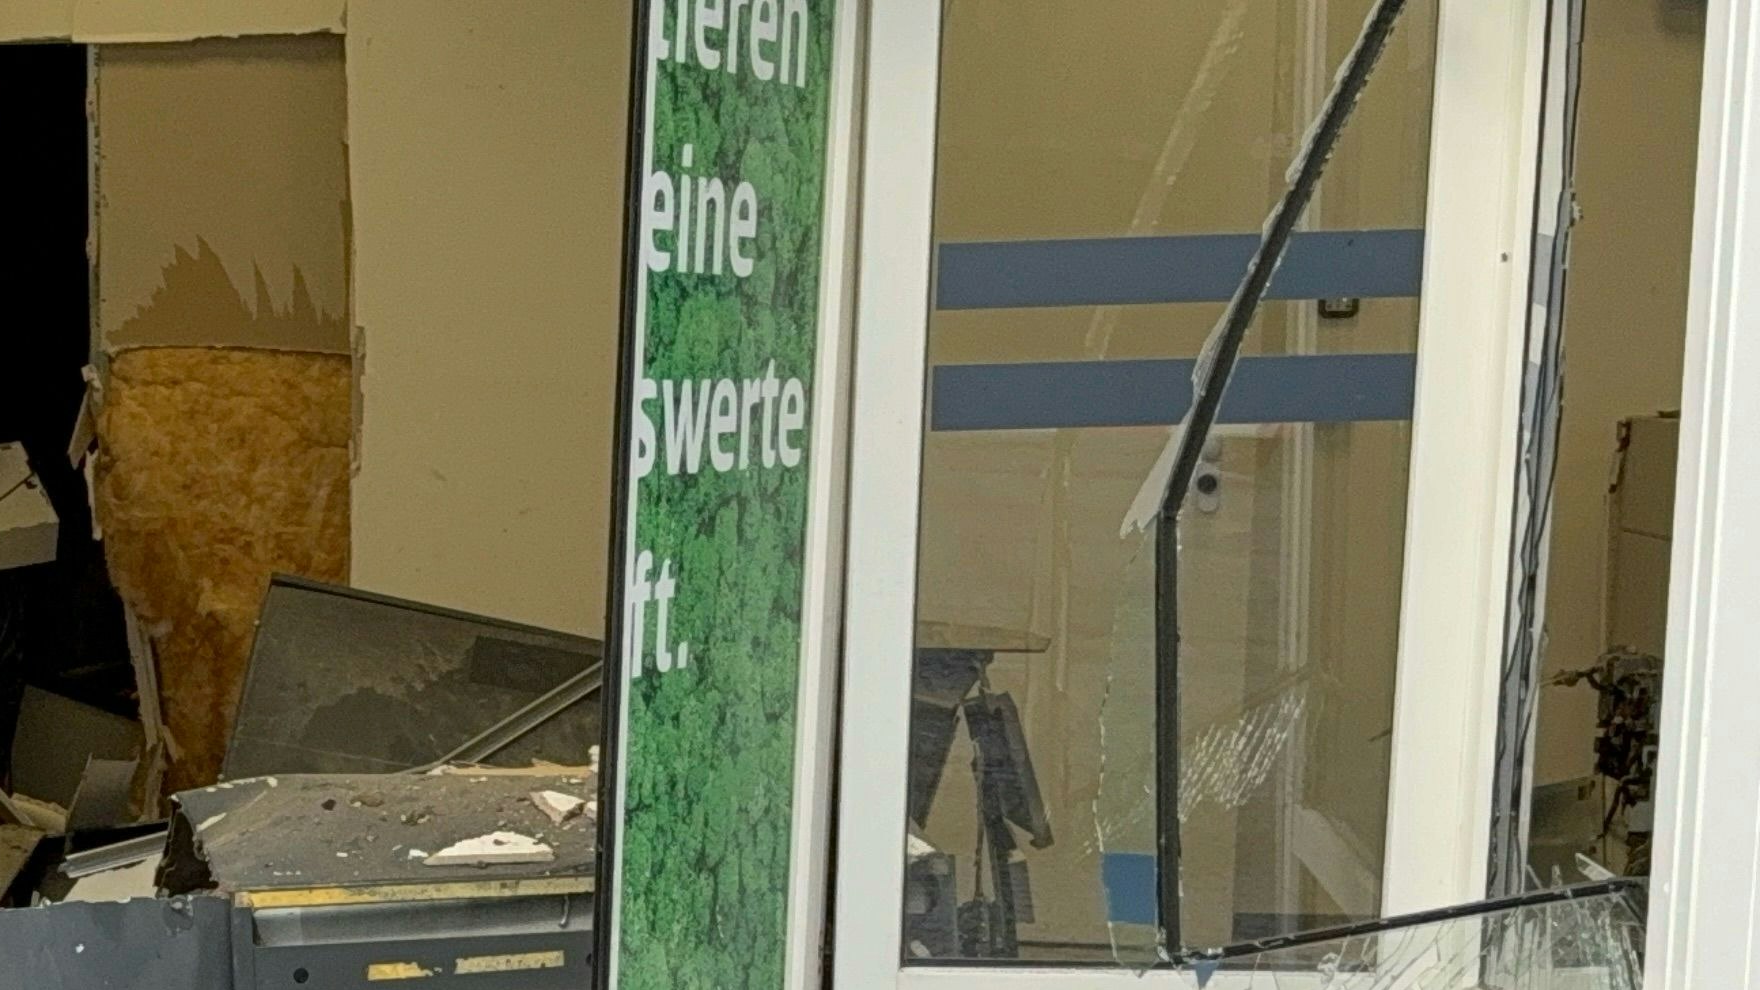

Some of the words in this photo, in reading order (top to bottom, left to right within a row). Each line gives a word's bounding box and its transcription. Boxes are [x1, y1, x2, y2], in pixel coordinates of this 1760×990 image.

[643, 143, 758, 278] eine
[631, 358, 805, 479] swerte
[629, 549, 689, 678] ft.
